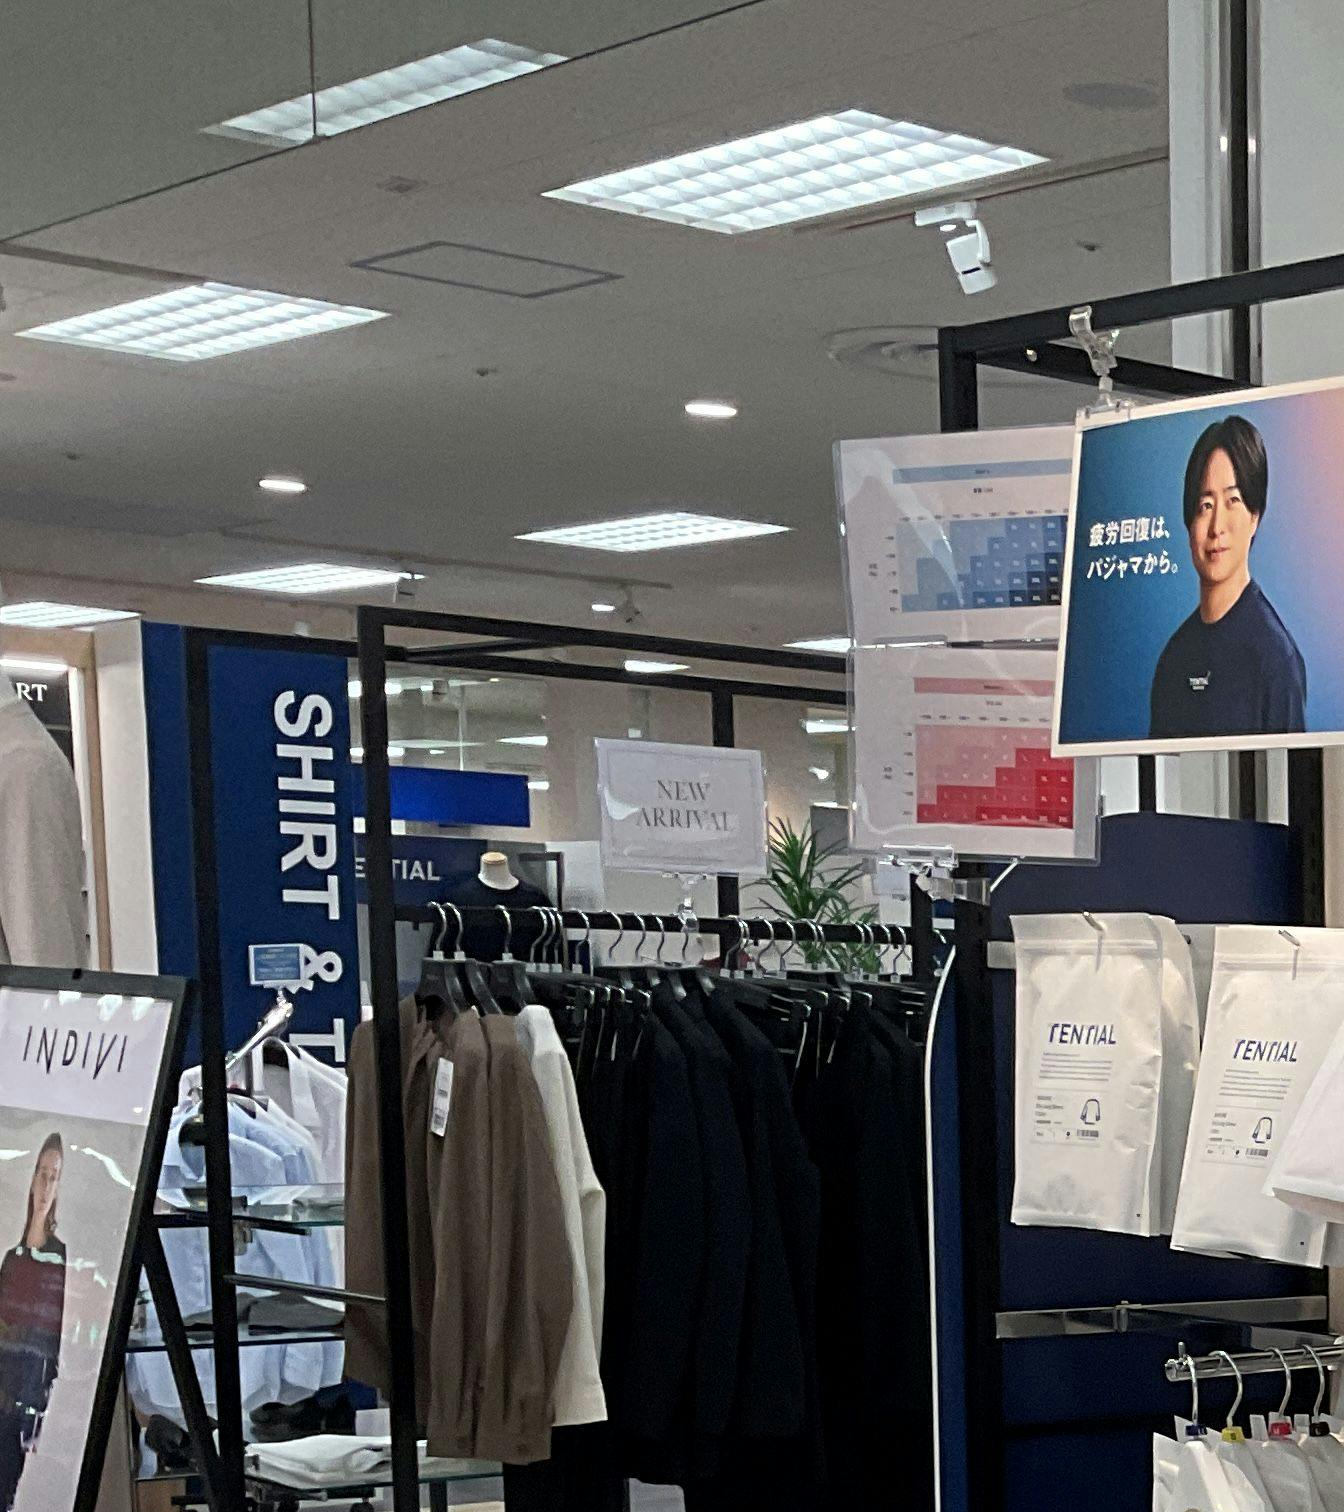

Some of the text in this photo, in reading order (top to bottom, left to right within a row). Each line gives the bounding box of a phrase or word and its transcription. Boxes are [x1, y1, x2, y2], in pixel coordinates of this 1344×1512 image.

[1089, 516, 1170, 547] 疲労回復は、
[1086, 550, 1179, 580] パジャマから。
[658, 780, 710, 801] NEW
[274, 690, 340, 920] SHIRT
[636, 807, 732, 831] ARRIVAL
[355, 857, 440, 880] ETIAL
[1048, 1022, 1117, 1045] TENTIAL
[23, 1025, 127, 1080] INDIVI
[1233, 1039, 1298, 1064] TENTIAL
